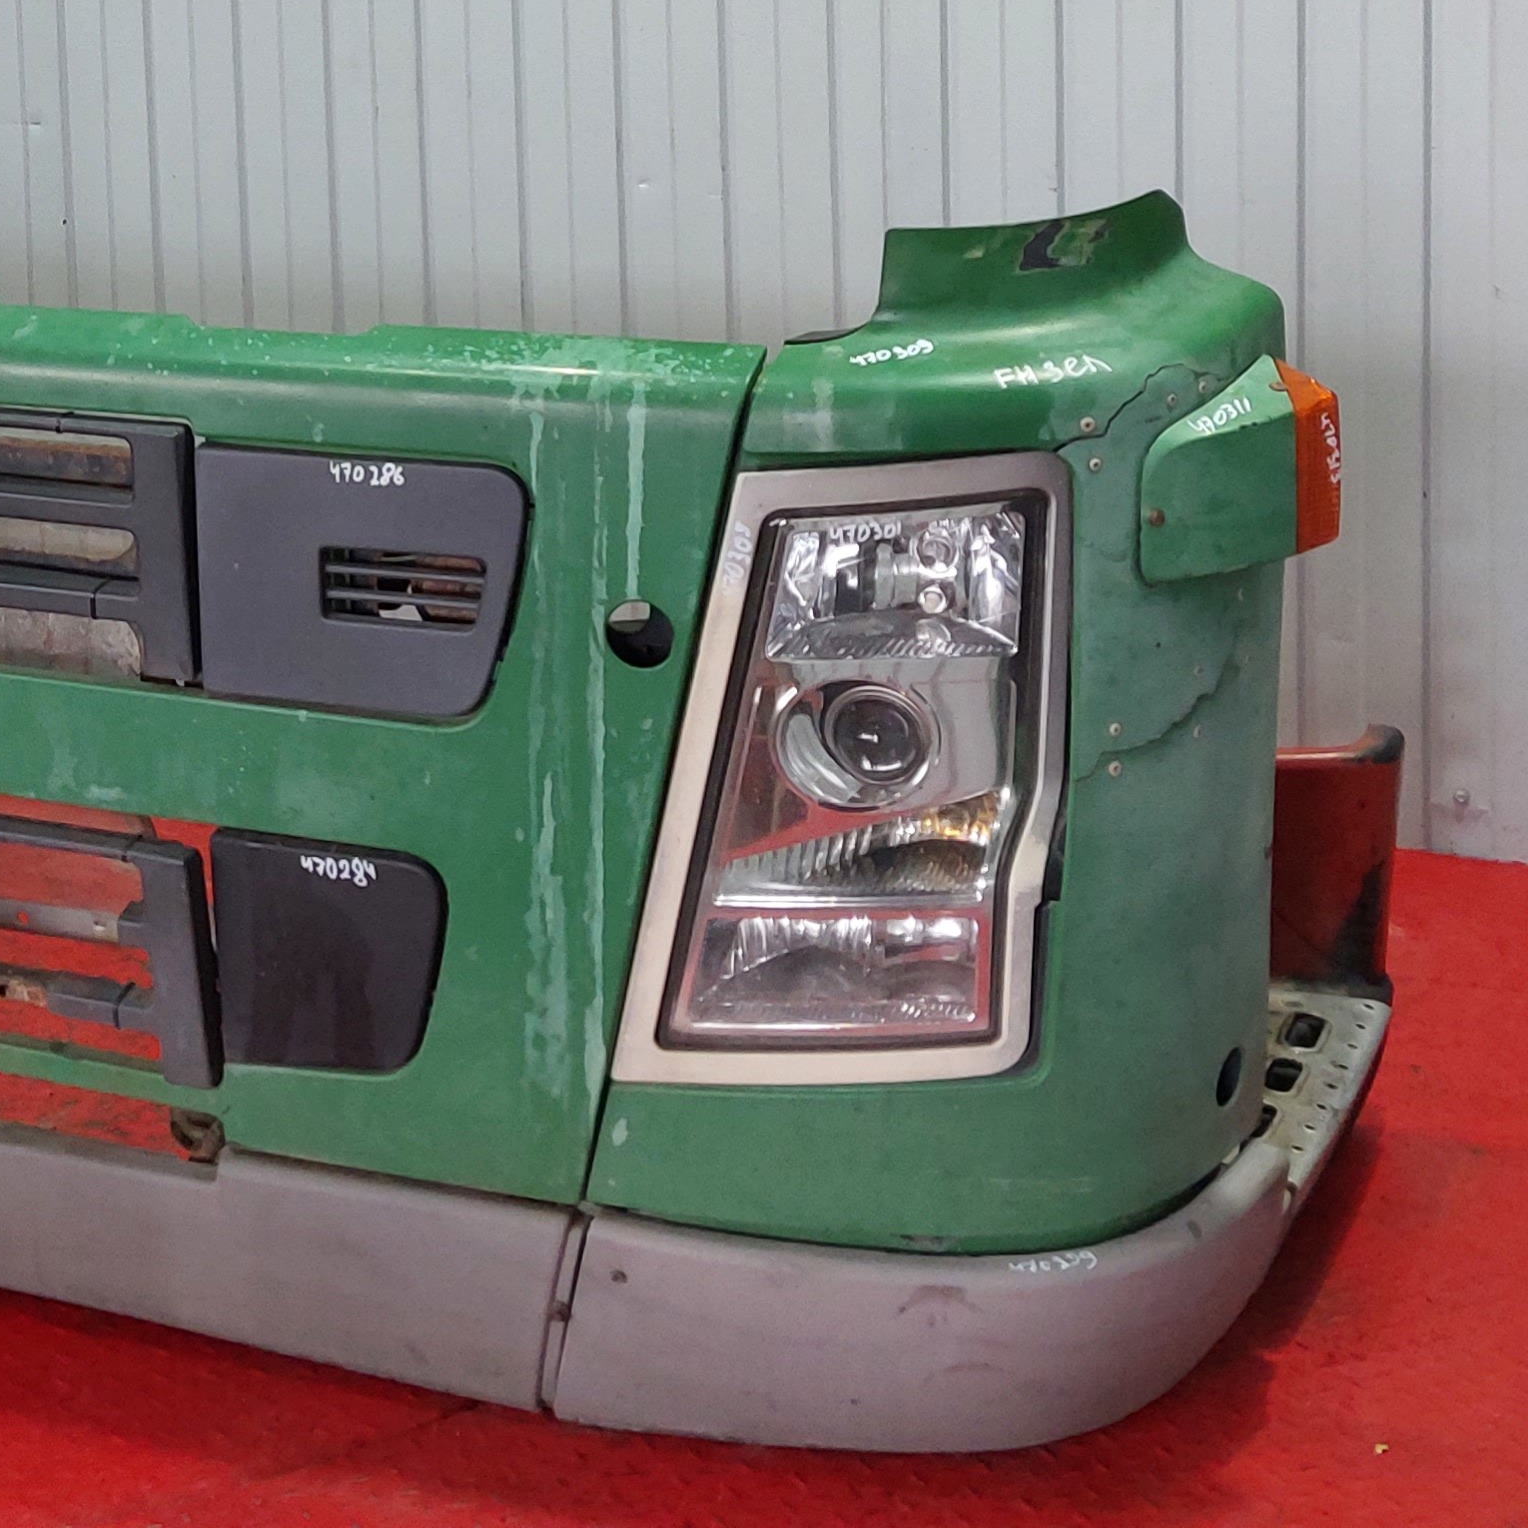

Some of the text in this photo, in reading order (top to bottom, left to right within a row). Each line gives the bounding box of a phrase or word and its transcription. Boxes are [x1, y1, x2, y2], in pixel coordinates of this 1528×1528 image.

[1188, 397, 1252, 435] 470311
[329, 460, 405, 487] 470286
[829, 521, 902, 544] 470301
[300, 855, 377, 887] 470284
